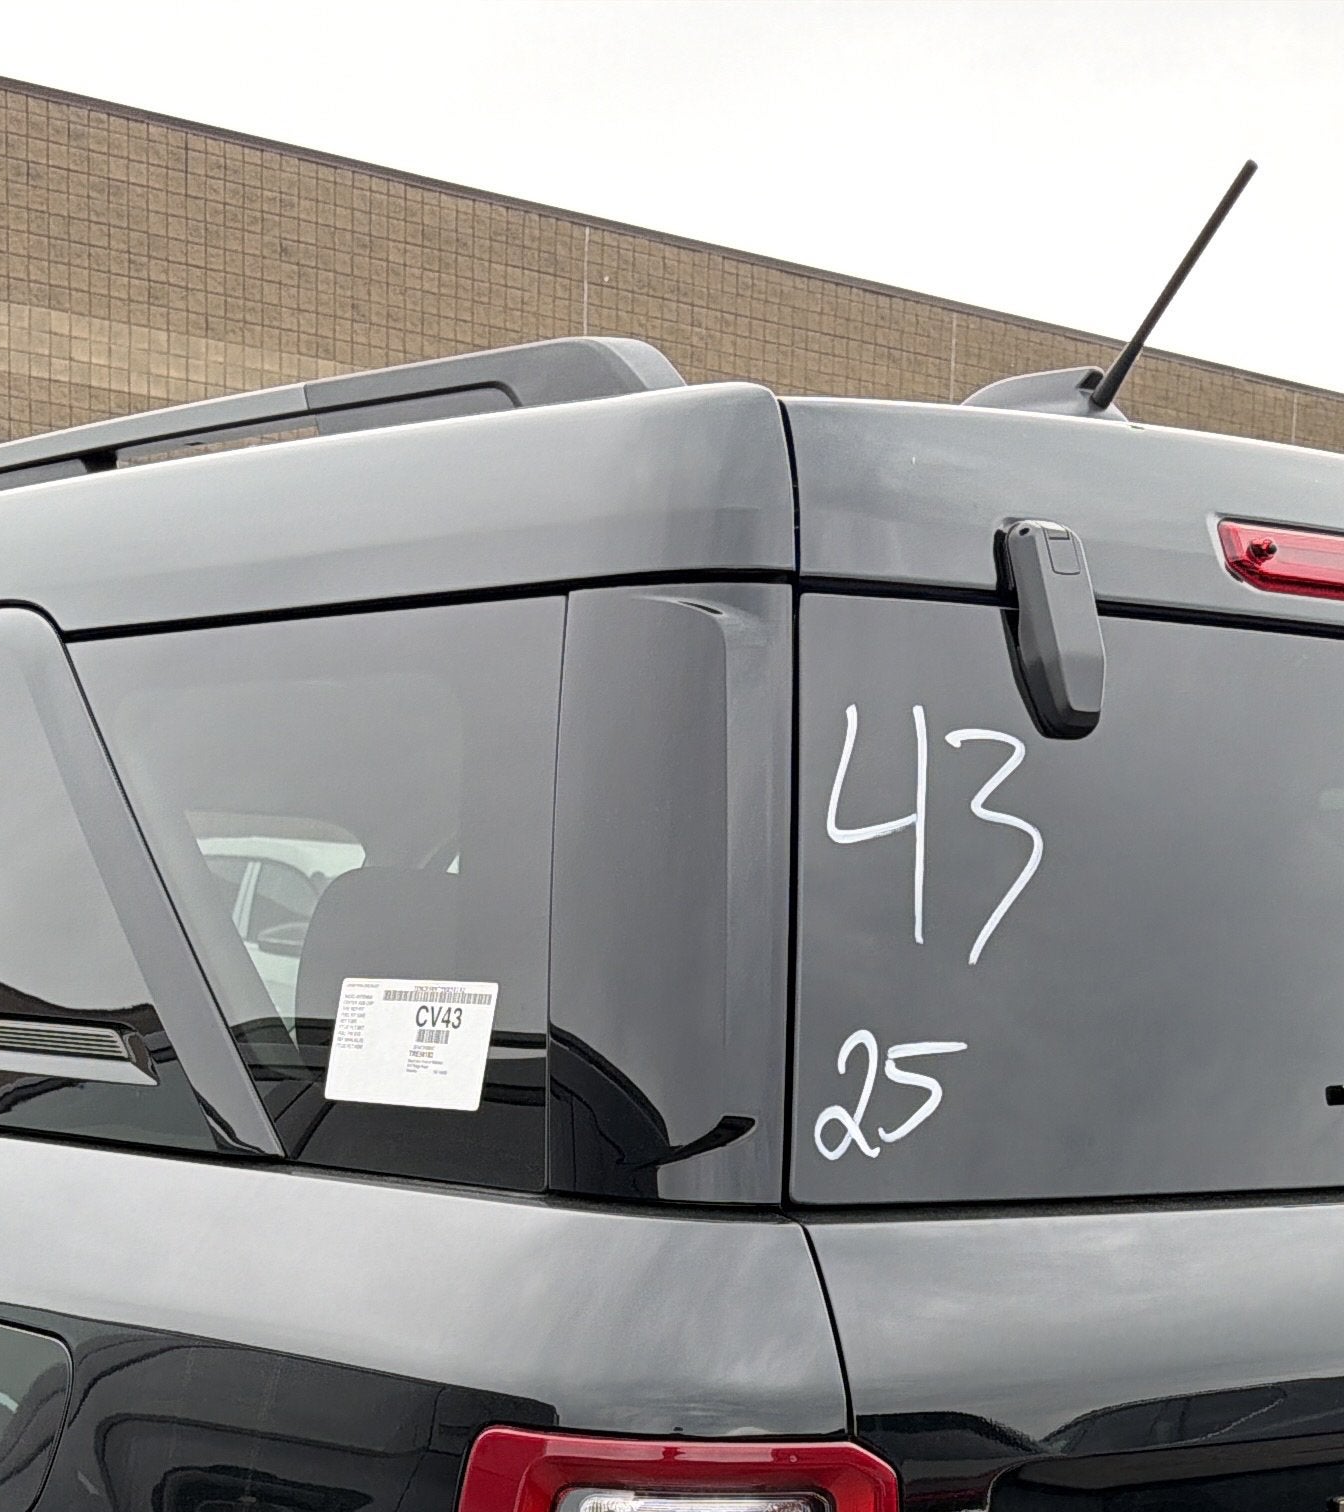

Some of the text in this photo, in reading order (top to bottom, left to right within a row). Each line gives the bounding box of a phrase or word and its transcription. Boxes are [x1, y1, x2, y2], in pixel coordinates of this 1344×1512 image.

[826, 704, 1044, 965] 43
[415, 1005, 463, 1029] CV43
[814, 1029, 968, 1161] 25
